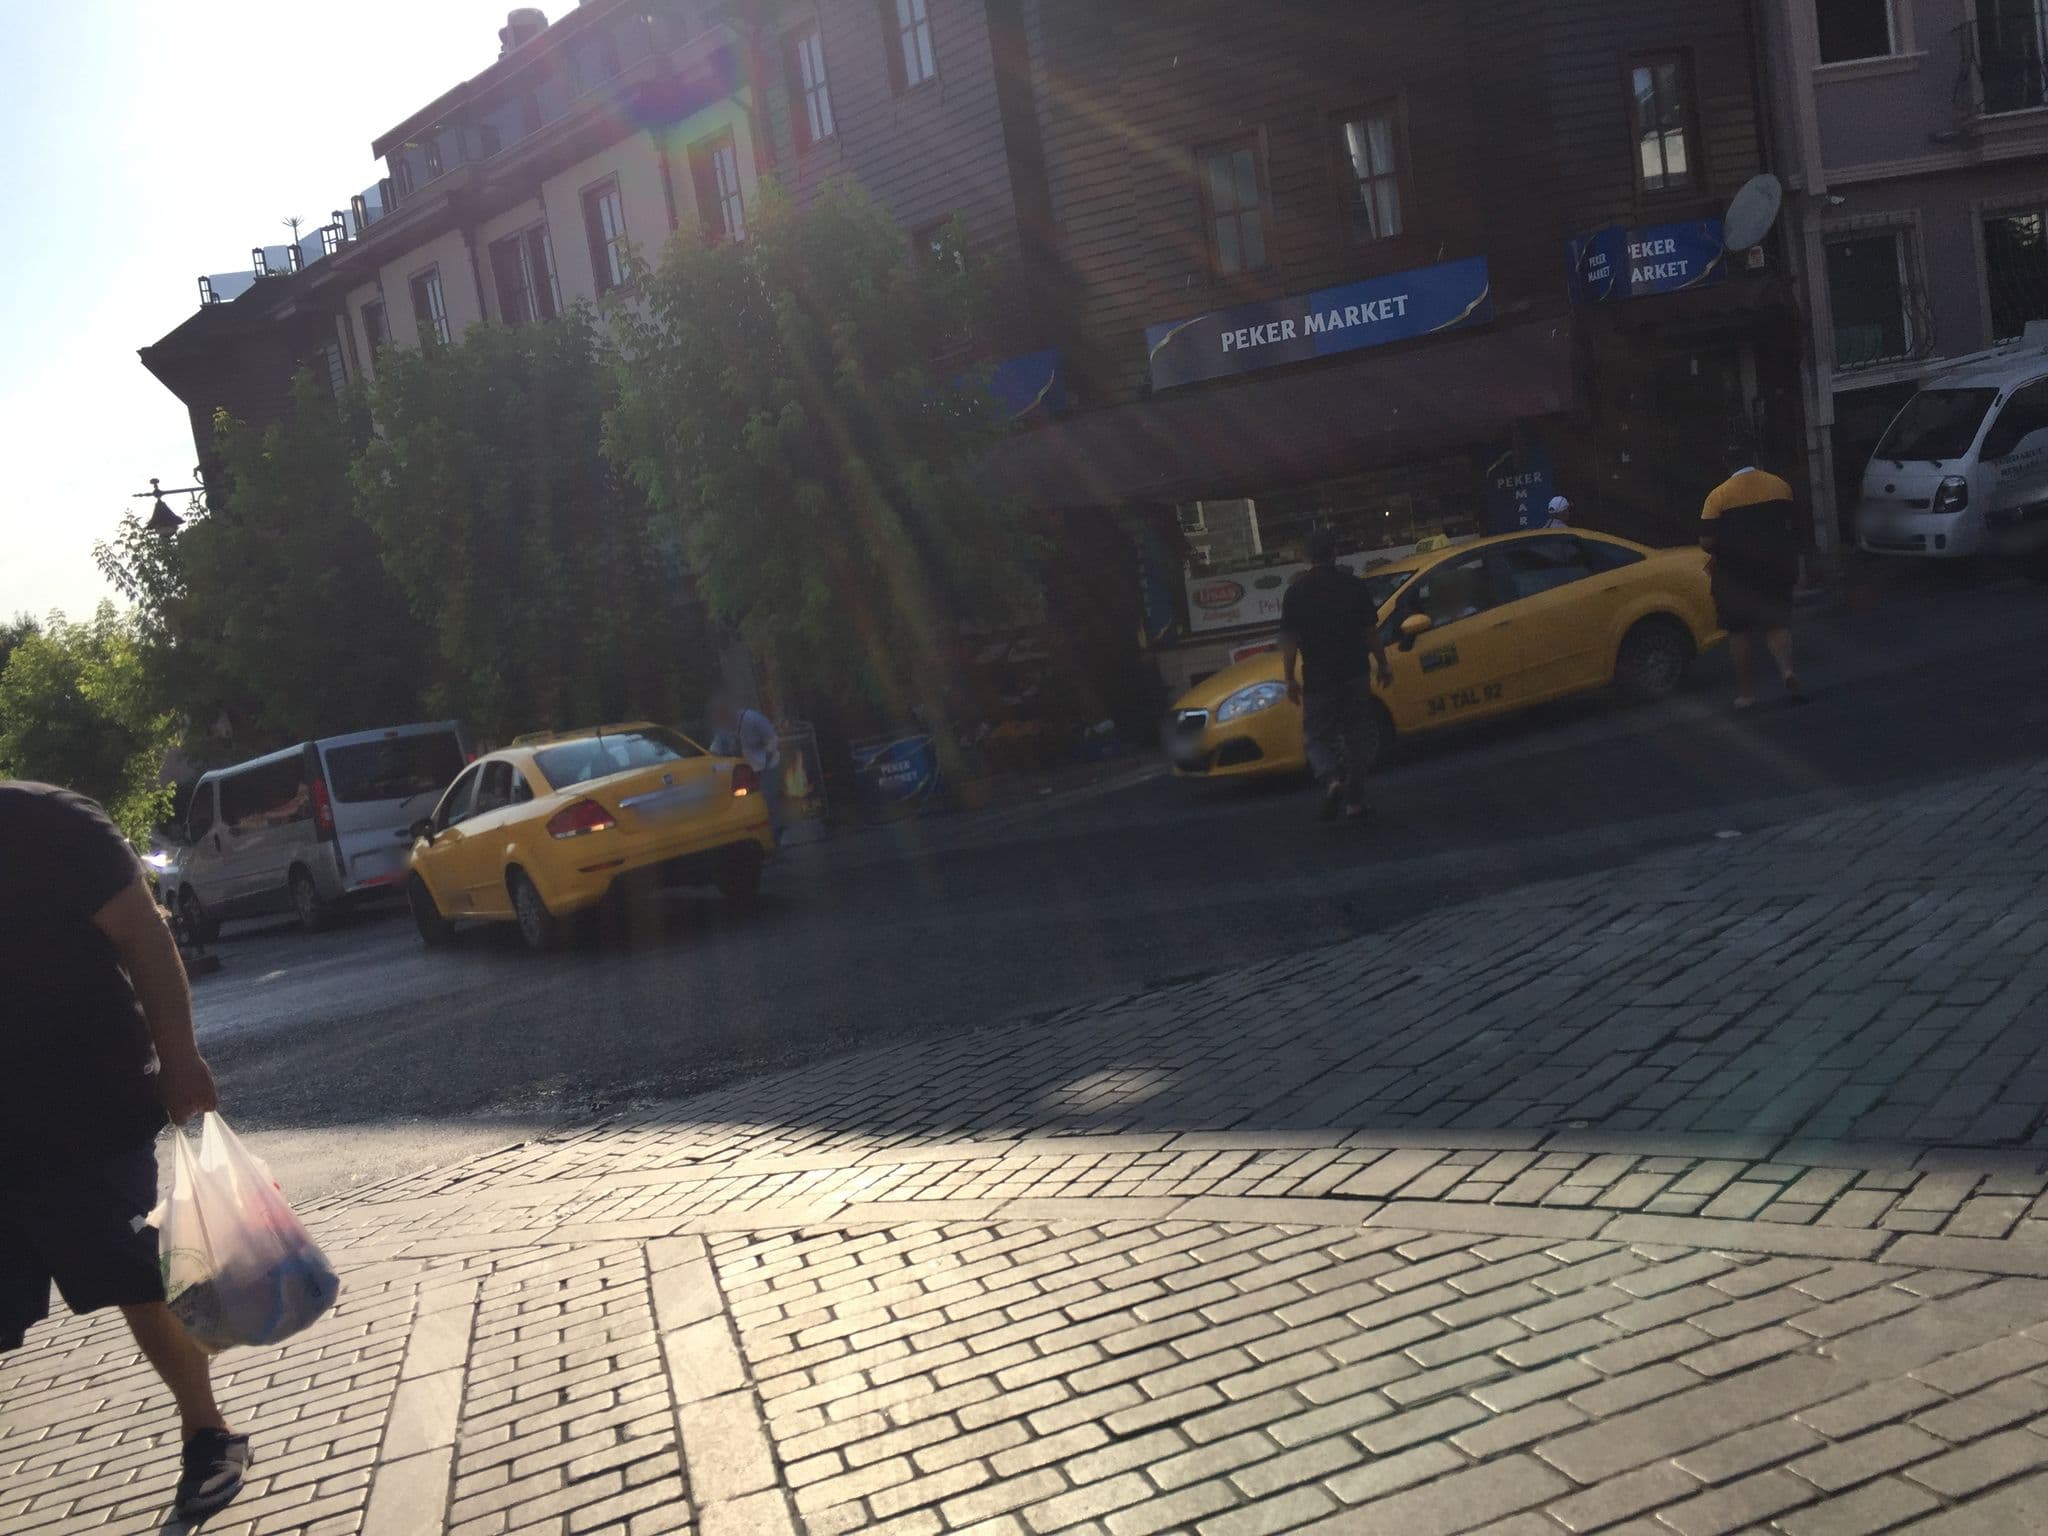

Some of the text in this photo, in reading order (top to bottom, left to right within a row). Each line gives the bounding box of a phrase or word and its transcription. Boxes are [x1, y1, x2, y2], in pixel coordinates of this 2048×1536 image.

[1589, 253, 1607, 267] PEKER
[1588, 266, 1611, 282] MARKET
[1221, 294, 1409, 352] PEKER MARKET
[1497, 472, 1543, 489] PEKER
